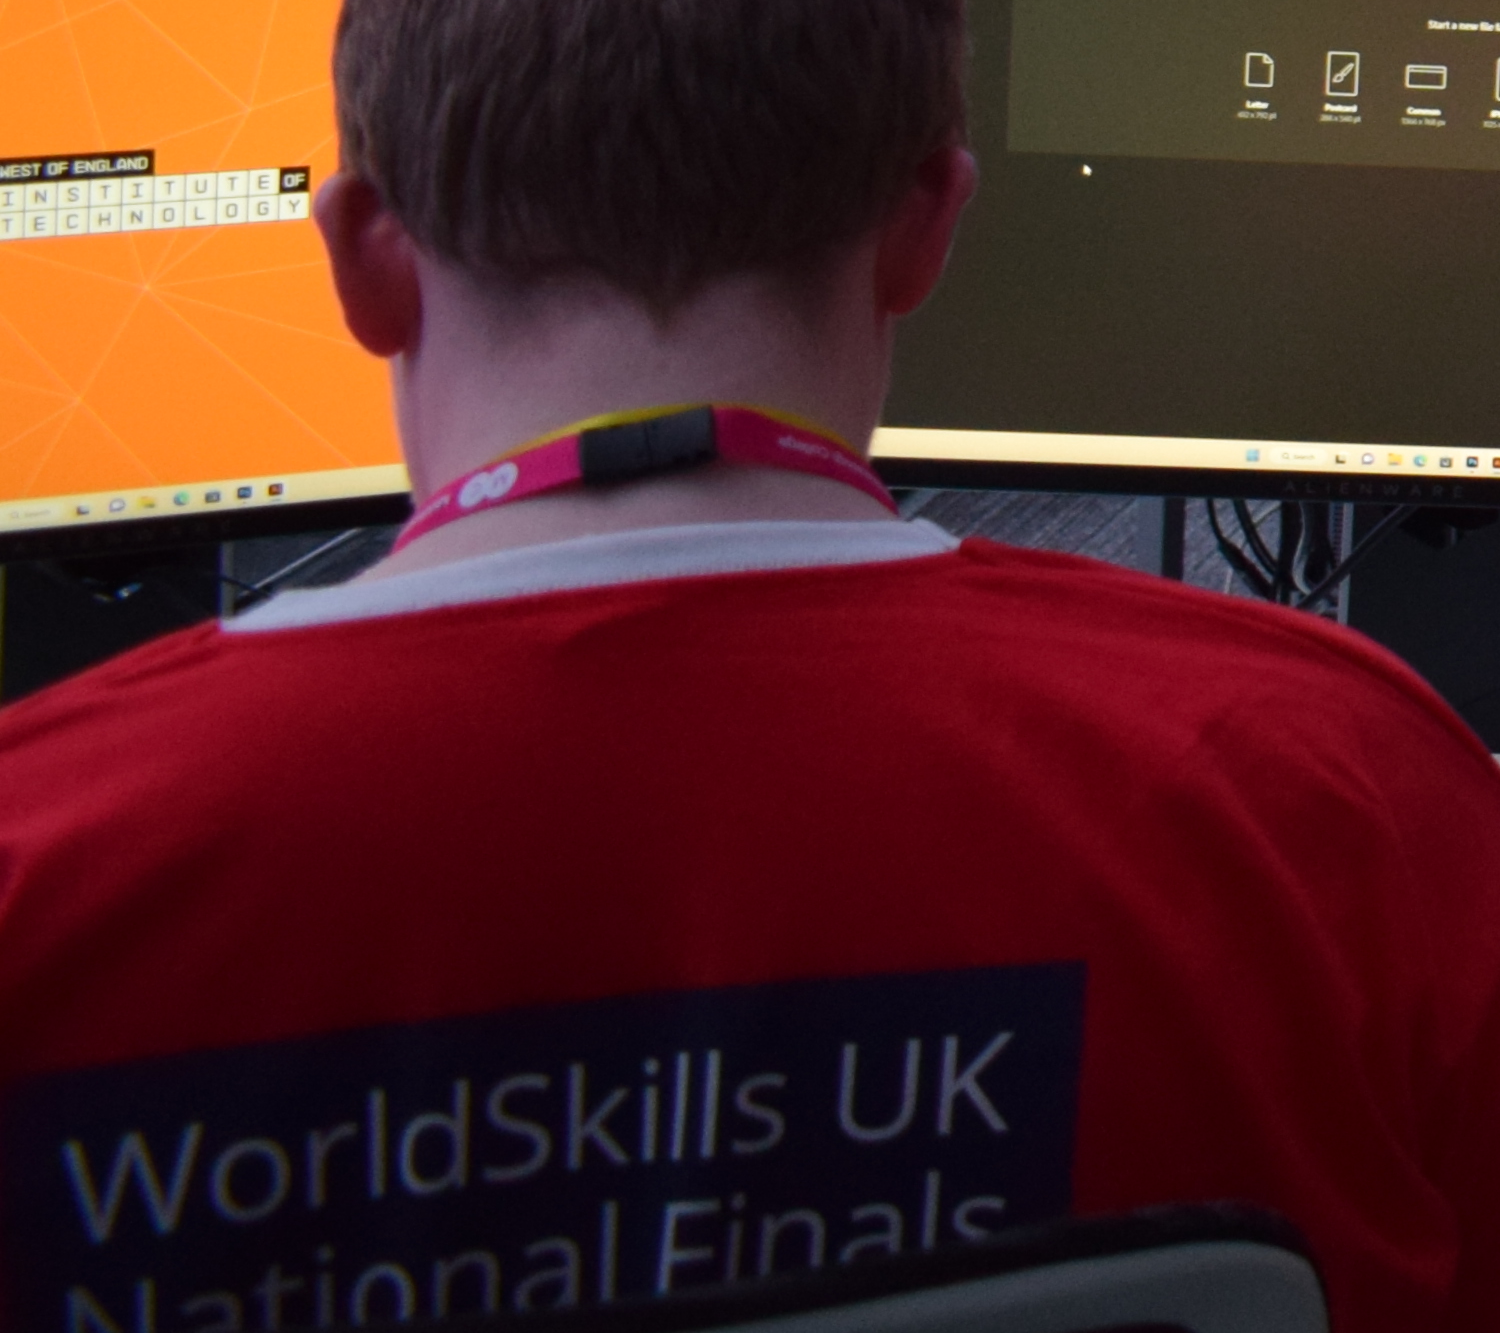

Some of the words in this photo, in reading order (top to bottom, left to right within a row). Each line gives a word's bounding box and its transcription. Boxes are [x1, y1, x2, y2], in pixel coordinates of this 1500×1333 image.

[1427, 19, 1450, 30] Start
[1459, 22, 1479, 31] new
[0, 163, 41, 180] WEST
[46, 162, 69, 177] OF
[73, 156, 149, 175] ENGLAND
[3, 174, 270, 207] INSTITUTE
[283, 172, 306, 188] OF
[0, 198, 302, 234] TECHNOLOGY
[1283, 480, 1464, 499] ALIENWARE
[62, 1049, 787, 1244] WorldSkills
[833, 1032, 1014, 1141] UK
[655, 1171, 1007, 1295] Finals
